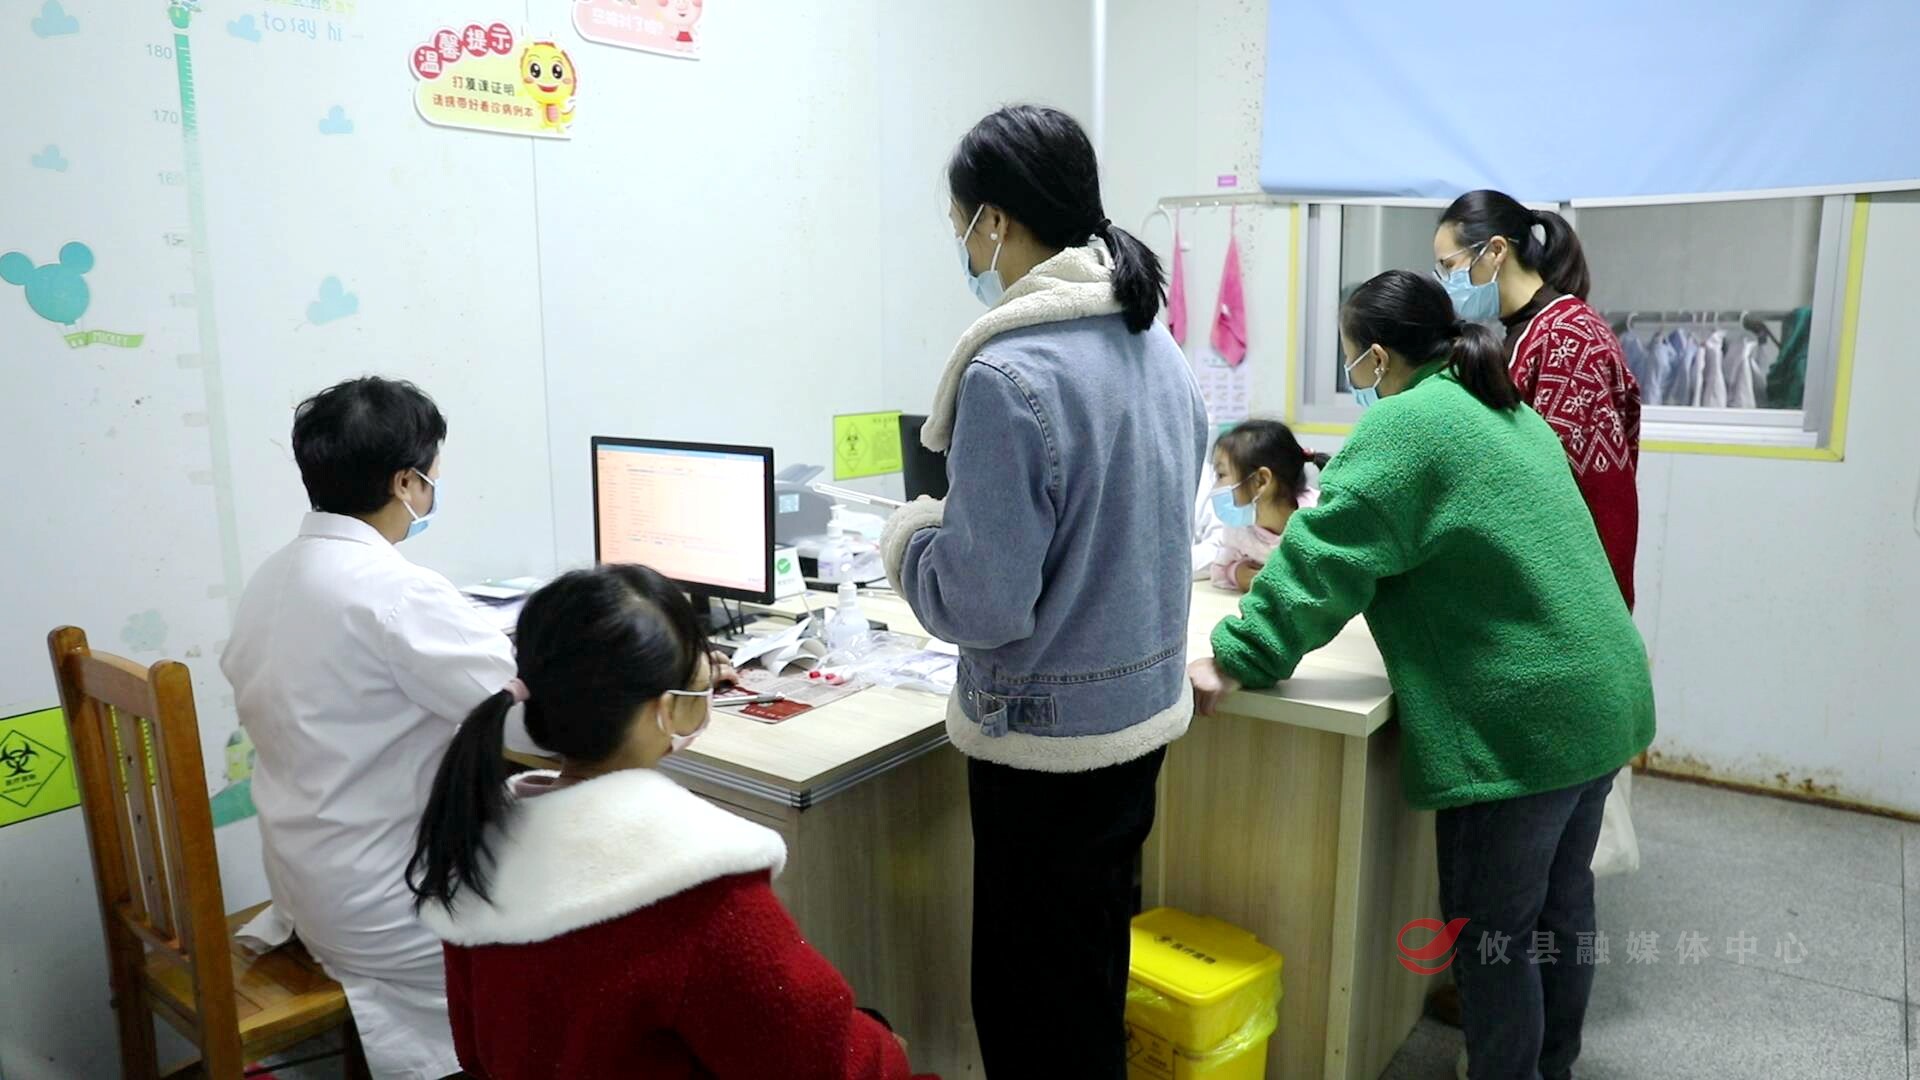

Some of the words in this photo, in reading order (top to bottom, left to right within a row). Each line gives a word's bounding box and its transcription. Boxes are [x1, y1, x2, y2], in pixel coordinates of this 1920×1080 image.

[261, 11, 286, 32] to
[290, 17, 316, 40] say
[328, 20, 342, 41] hi
[146, 44, 173, 60] 180
[417, 25, 512, 74] 温馨提示
[153, 109, 179, 125] 170
